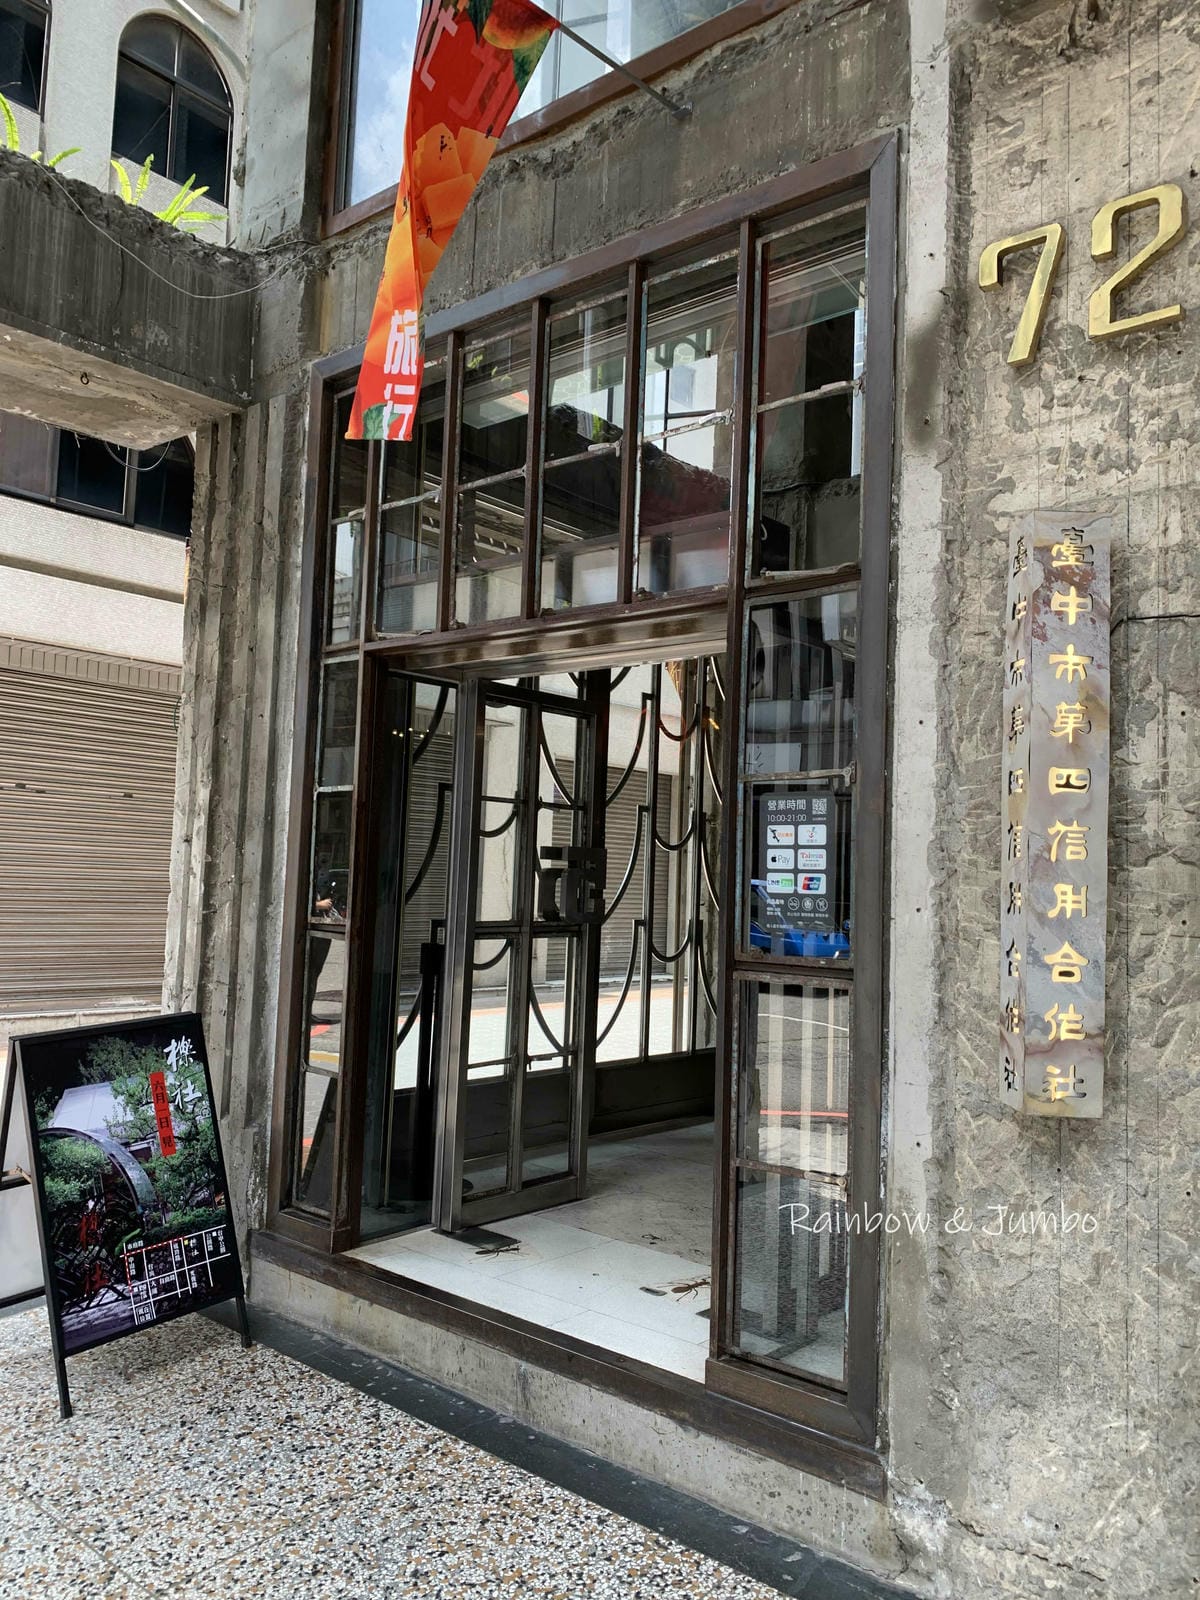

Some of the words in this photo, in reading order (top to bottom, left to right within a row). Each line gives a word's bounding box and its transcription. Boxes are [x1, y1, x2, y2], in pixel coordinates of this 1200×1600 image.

[978, 183, 1188, 367] 72
[767, 799, 807, 811] 營業時間
[767, 814, 807, 822] 10:00-21:00
